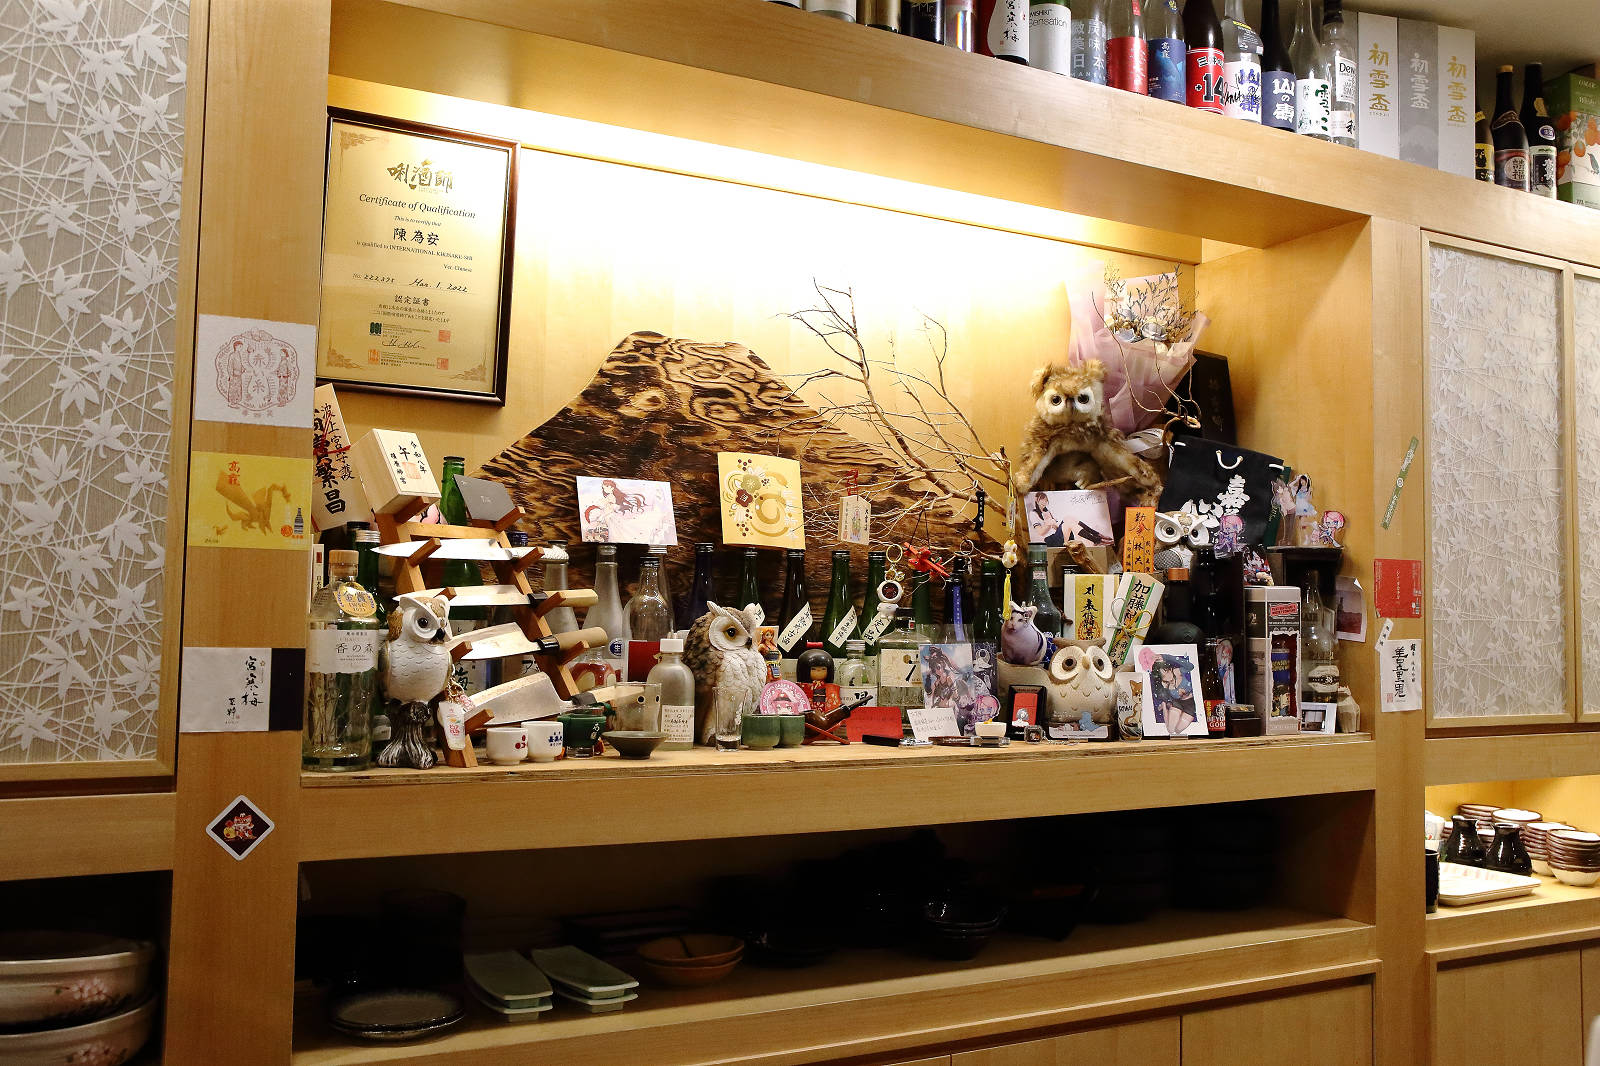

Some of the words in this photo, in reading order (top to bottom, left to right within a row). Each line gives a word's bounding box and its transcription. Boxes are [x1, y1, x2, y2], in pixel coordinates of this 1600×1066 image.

[1368, 42, 1391, 112] 初雪盃
[1447, 55, 1468, 123] 初雪盃
[359, 193, 407, 209] Certificate
[408, 201, 419, 211] of
[419, 202, 477, 219] Qualification
[393, 227, 440, 246] 陳為安
[389, 245, 435, 256] INTERNATIONAL
